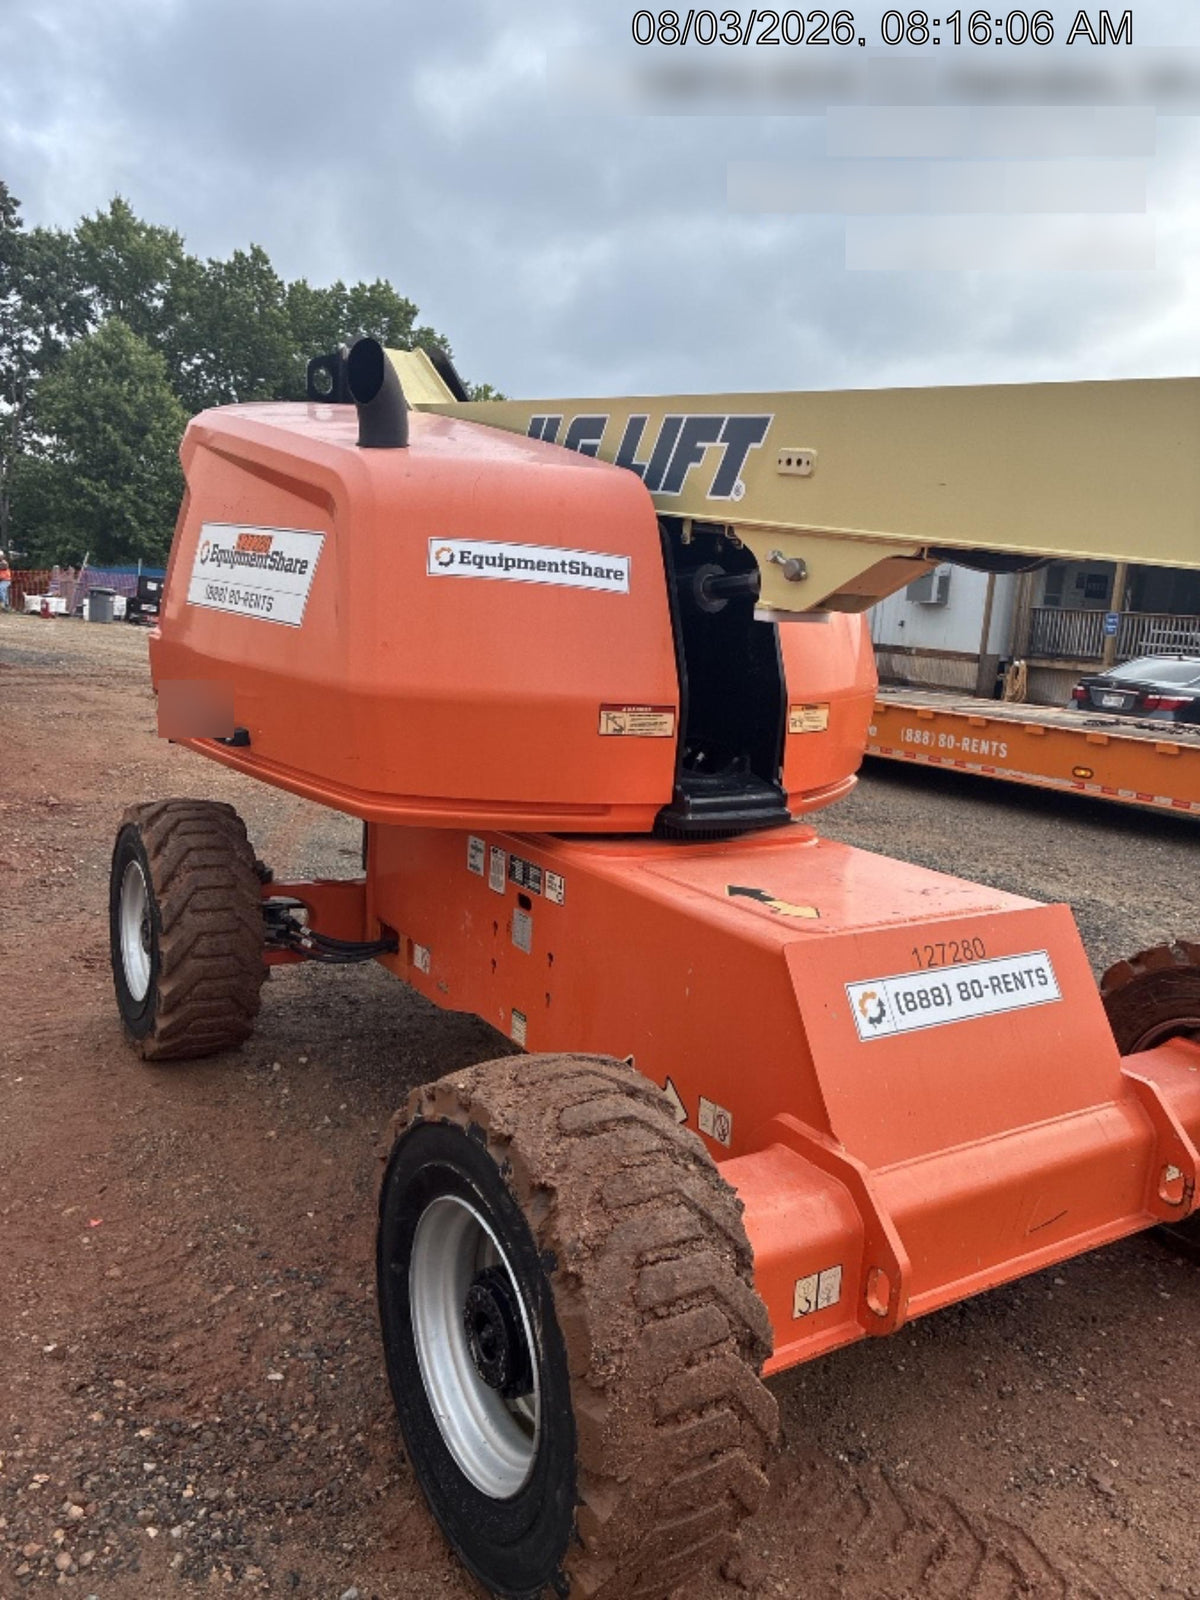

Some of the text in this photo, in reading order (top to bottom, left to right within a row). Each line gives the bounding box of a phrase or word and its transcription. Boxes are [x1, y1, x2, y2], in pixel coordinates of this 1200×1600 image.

[208, 543, 309, 576] EquipmentShare
[458, 550, 626, 582] EquipmentShare
[900, 727, 937, 748] (888)
[937, 732, 1009, 759] 80-RENTS
[911, 936, 987, 969] 127280
[893, 966, 1050, 1016] (888) 80-RENTS
